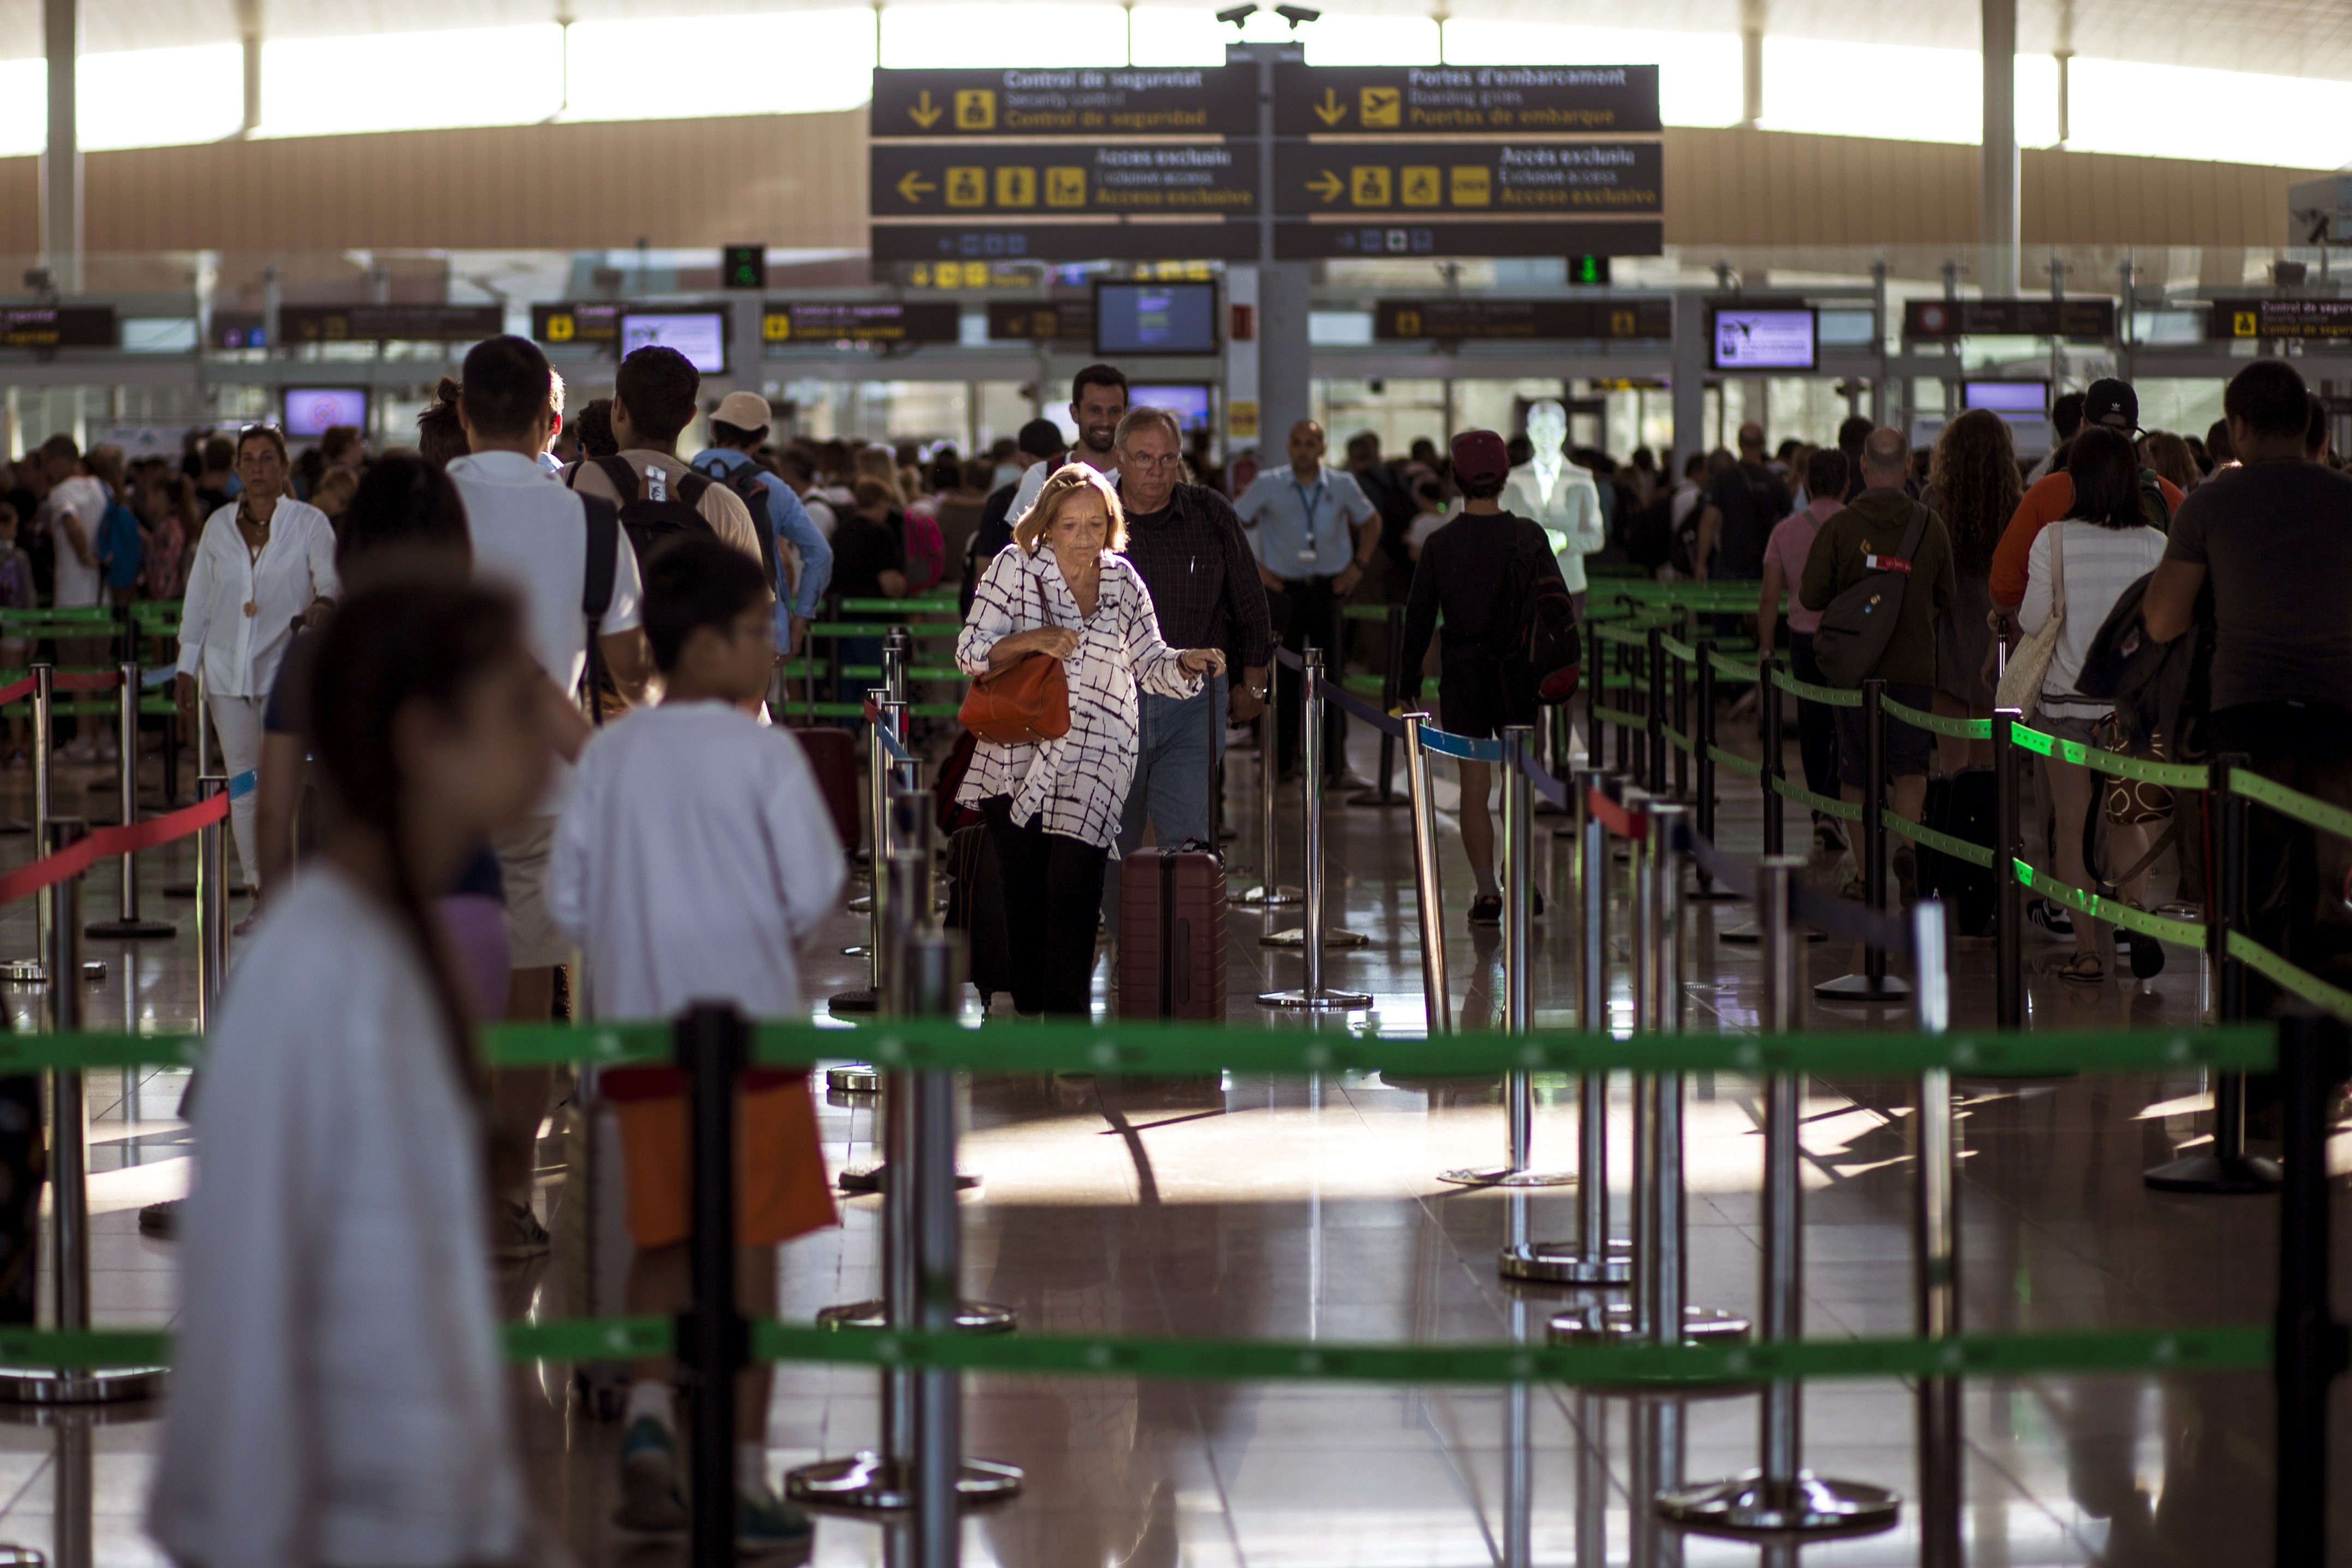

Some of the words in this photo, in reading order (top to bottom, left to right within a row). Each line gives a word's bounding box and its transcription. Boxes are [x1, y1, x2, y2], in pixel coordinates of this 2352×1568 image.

[1004, 71, 1076, 88] Control
[1080, 71, 1105, 87] de
[1110, 71, 1203, 91] seguretat
[1409, 69, 1472, 86] Portes
[1477, 68, 1627, 86] d'embarcament
[1004, 110, 1076, 127] Control
[1080, 110, 1105, 127] de
[1110, 109, 1207, 129] seguridad
[1409, 108, 1485, 126] Puertas
[1489, 108, 1514, 126] de
[1519, 107, 1615, 128] embarque
[1559, 146, 1635, 165] exclusiu
[1500, 186, 1568, 205] Acceso
[1570, 186, 1657, 205] exclusivo
[2261, 301, 2301, 314] Control
[2303, 301, 2317, 313] de
